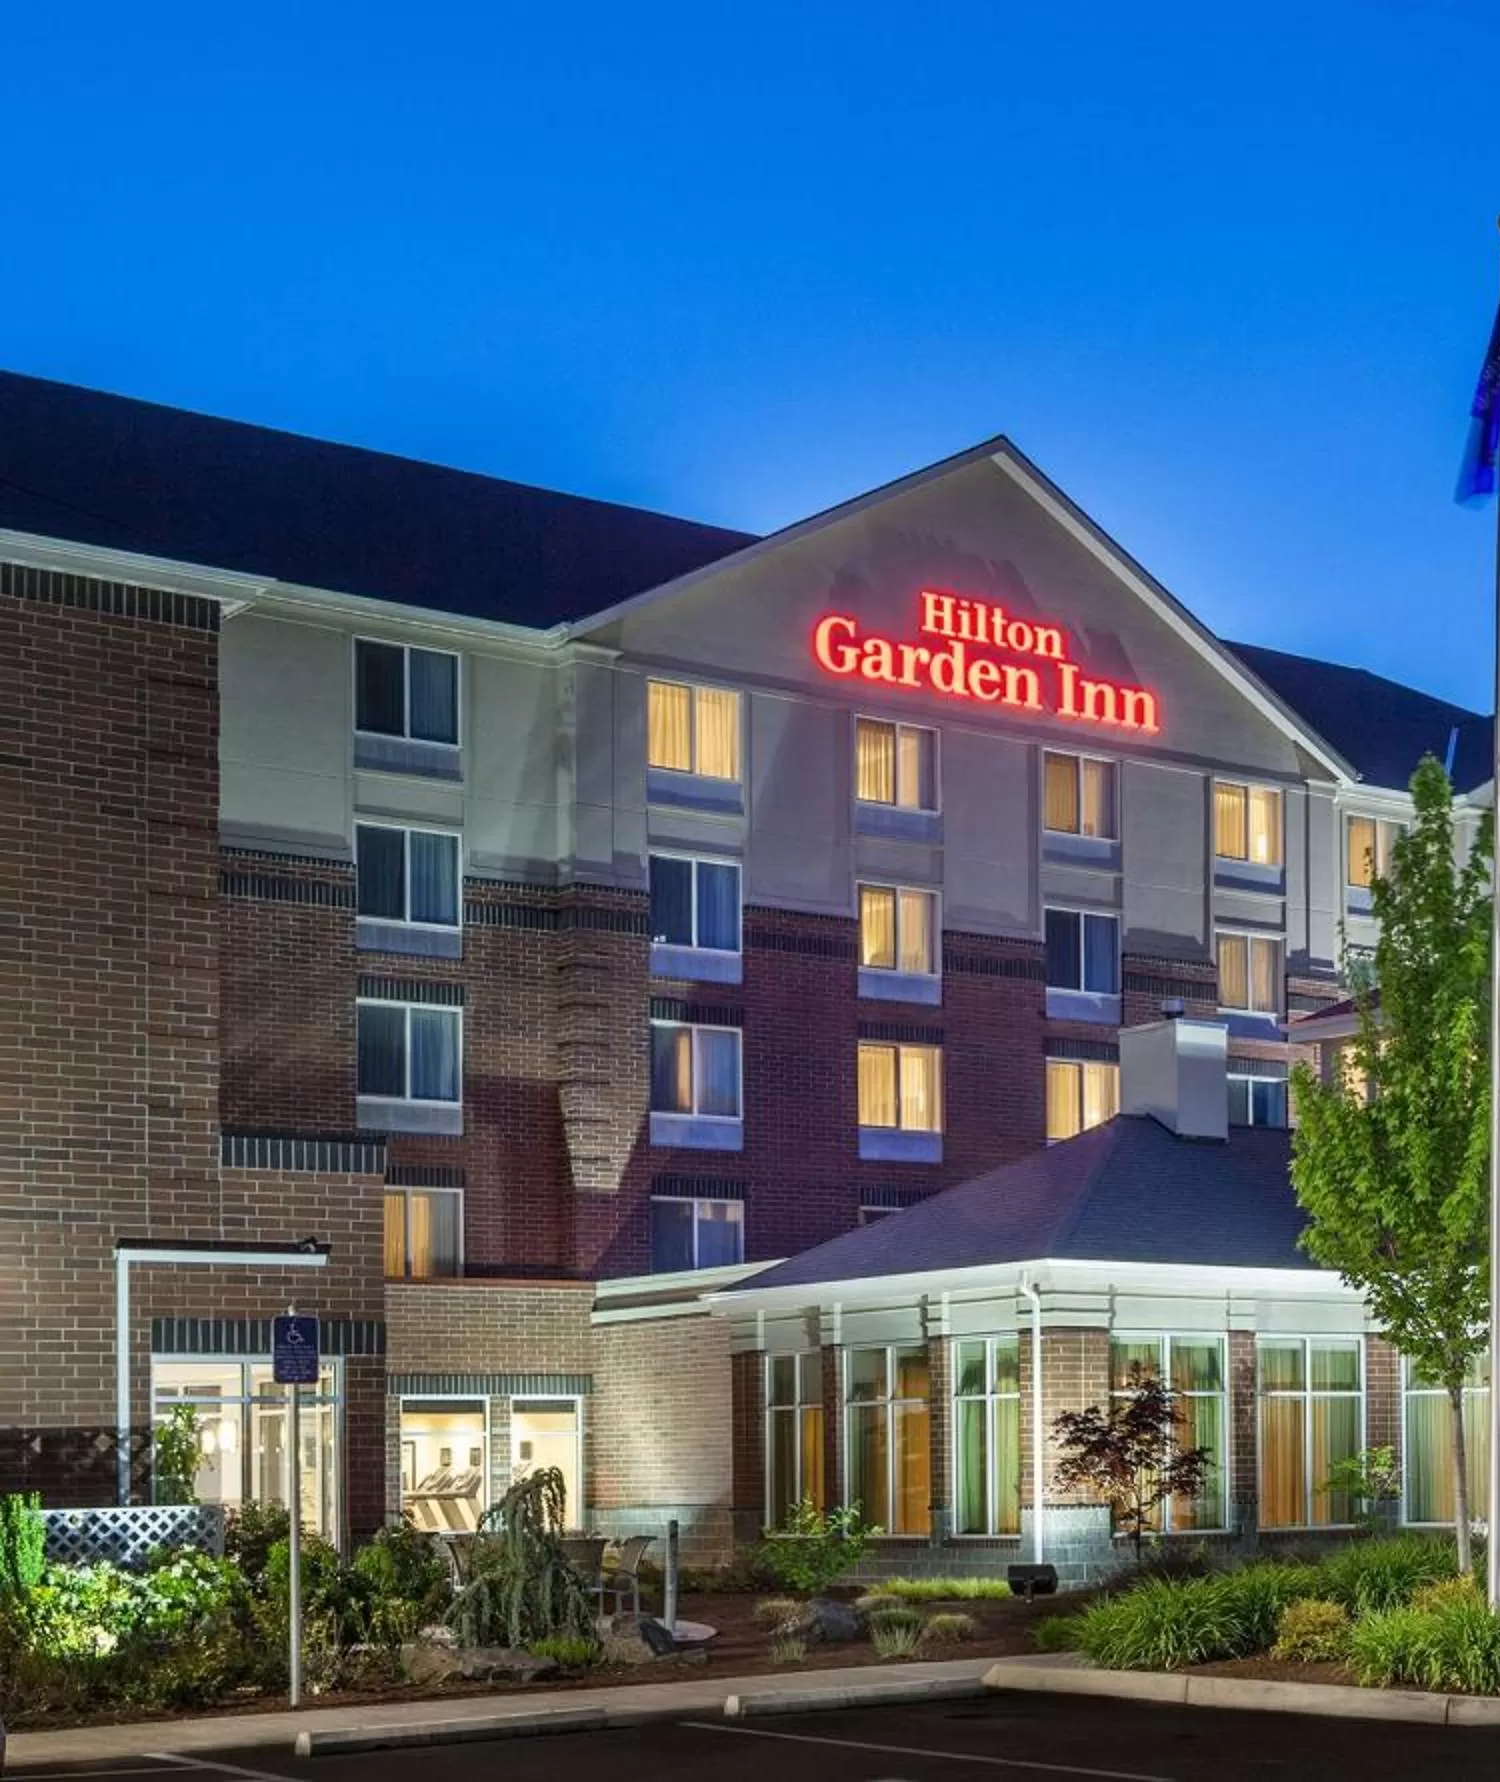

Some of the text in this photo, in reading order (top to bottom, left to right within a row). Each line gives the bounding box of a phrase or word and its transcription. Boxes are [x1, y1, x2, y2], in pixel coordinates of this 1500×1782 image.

[920, 590, 1066, 661] Hilton
[814, 615, 1160, 733] Garden Inn
